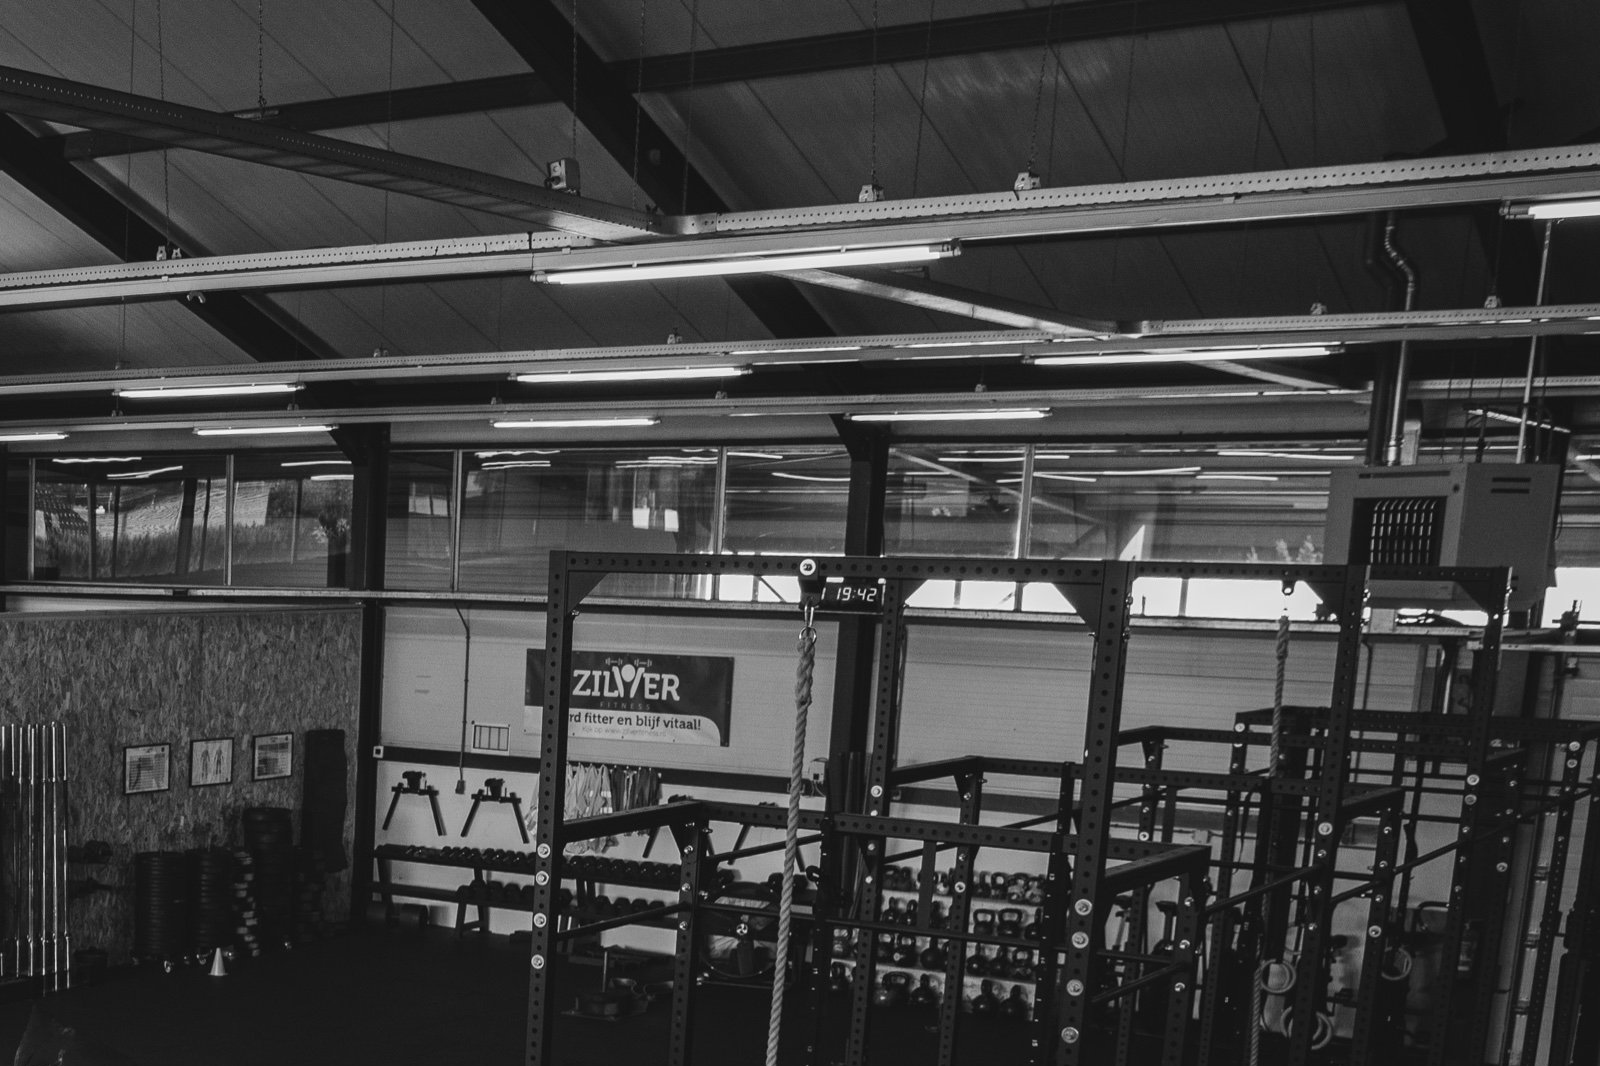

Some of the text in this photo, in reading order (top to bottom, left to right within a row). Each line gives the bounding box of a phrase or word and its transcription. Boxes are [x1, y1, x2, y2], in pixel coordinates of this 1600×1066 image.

[836, 586, 877, 602] 19:42
[572, 664, 680, 701] ZILVER
[599, 702, 651, 711] FITNESS
[584, 712, 614, 725] fitter
[617, 716, 632, 726] en
[636, 715, 661, 730] blijf
[663, 718, 701, 731] vitaal!
